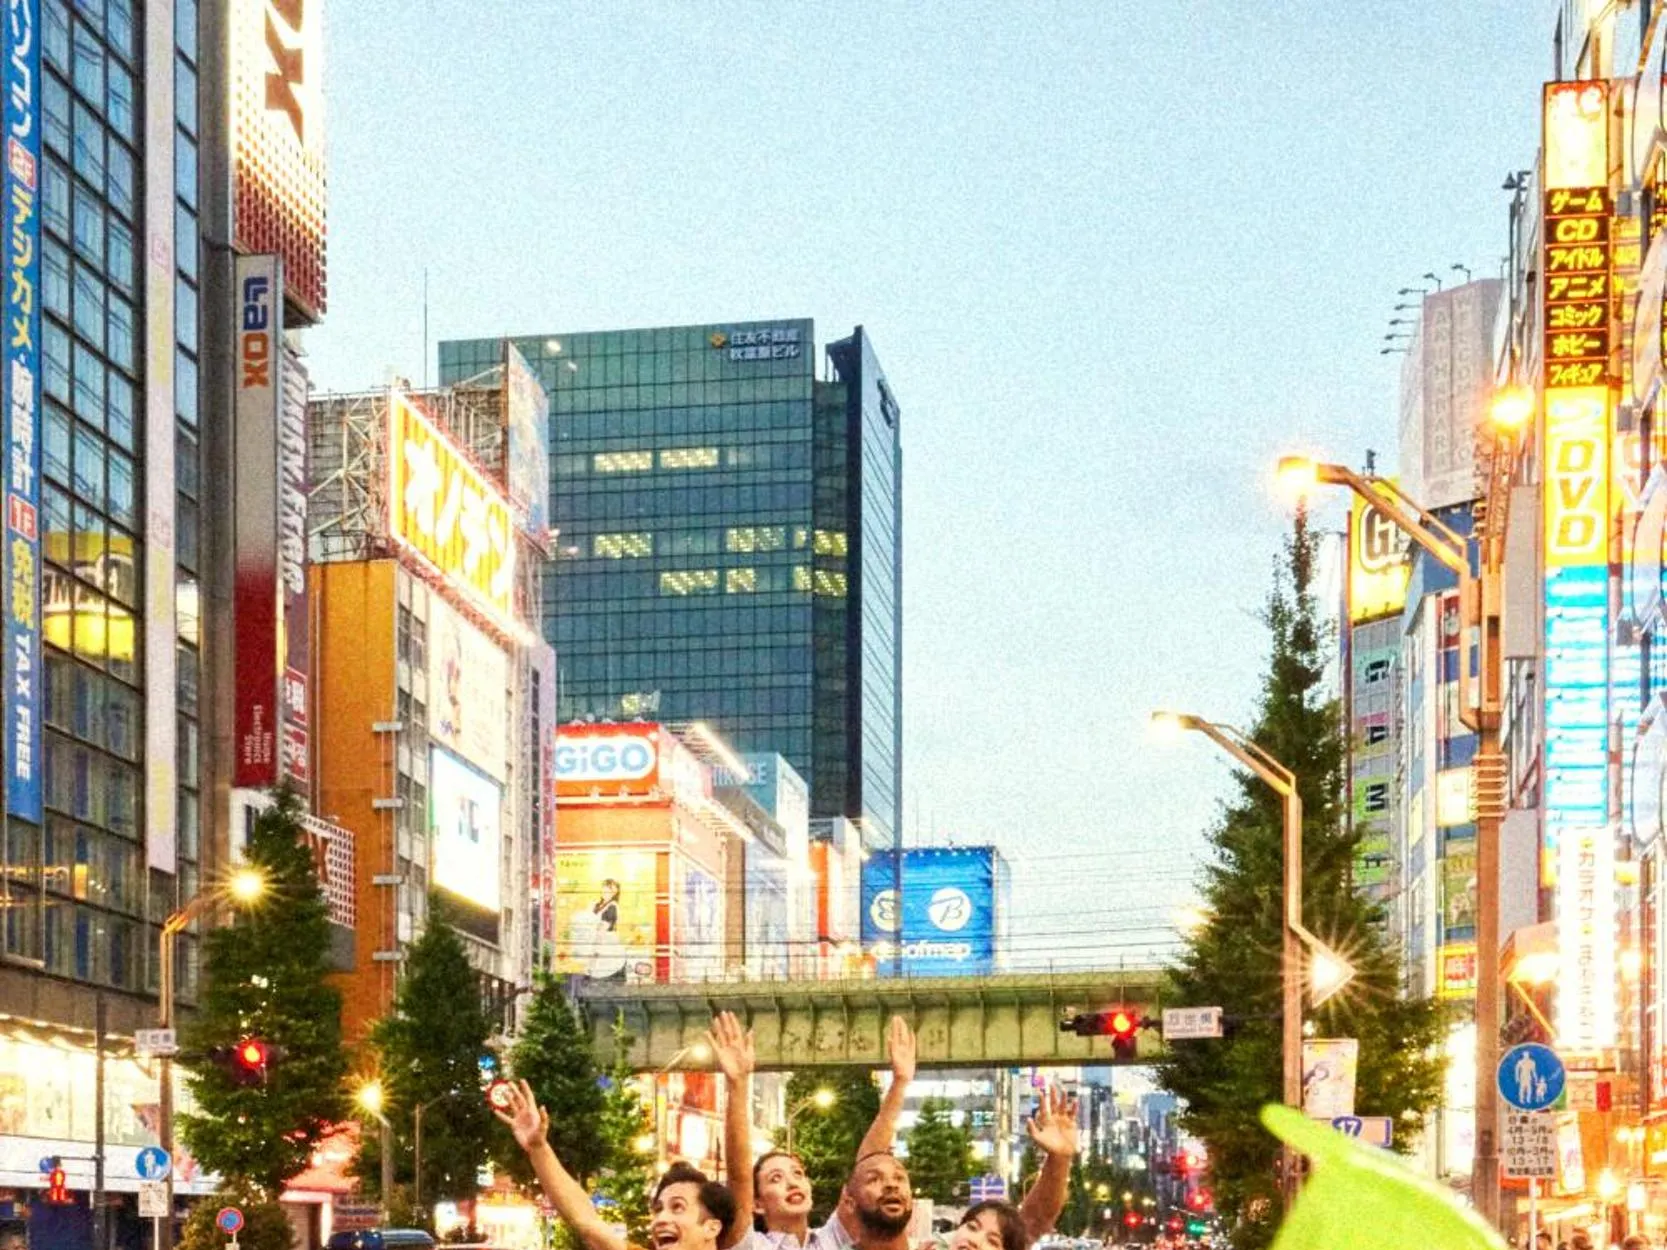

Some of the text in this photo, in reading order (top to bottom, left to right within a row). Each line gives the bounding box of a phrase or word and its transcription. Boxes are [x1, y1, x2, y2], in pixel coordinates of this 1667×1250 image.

[1549, 192, 1604, 214] ゲーム
[1555, 219, 1598, 242] CD
[1549, 248, 1604, 270] アイドル
[1549, 278, 1604, 299] アニメ
[1549, 306, 1603, 328] コミック
[1551, 334, 1602, 357] ホビー
[1549, 363, 1603, 386] フィギュア
[1554, 439, 1598, 549] DVD
[15, 634, 30, 699] TAX
[16, 704, 31, 781] FREE
[243, 733, 253, 765] Store
[555, 742, 649, 775] GiGO
